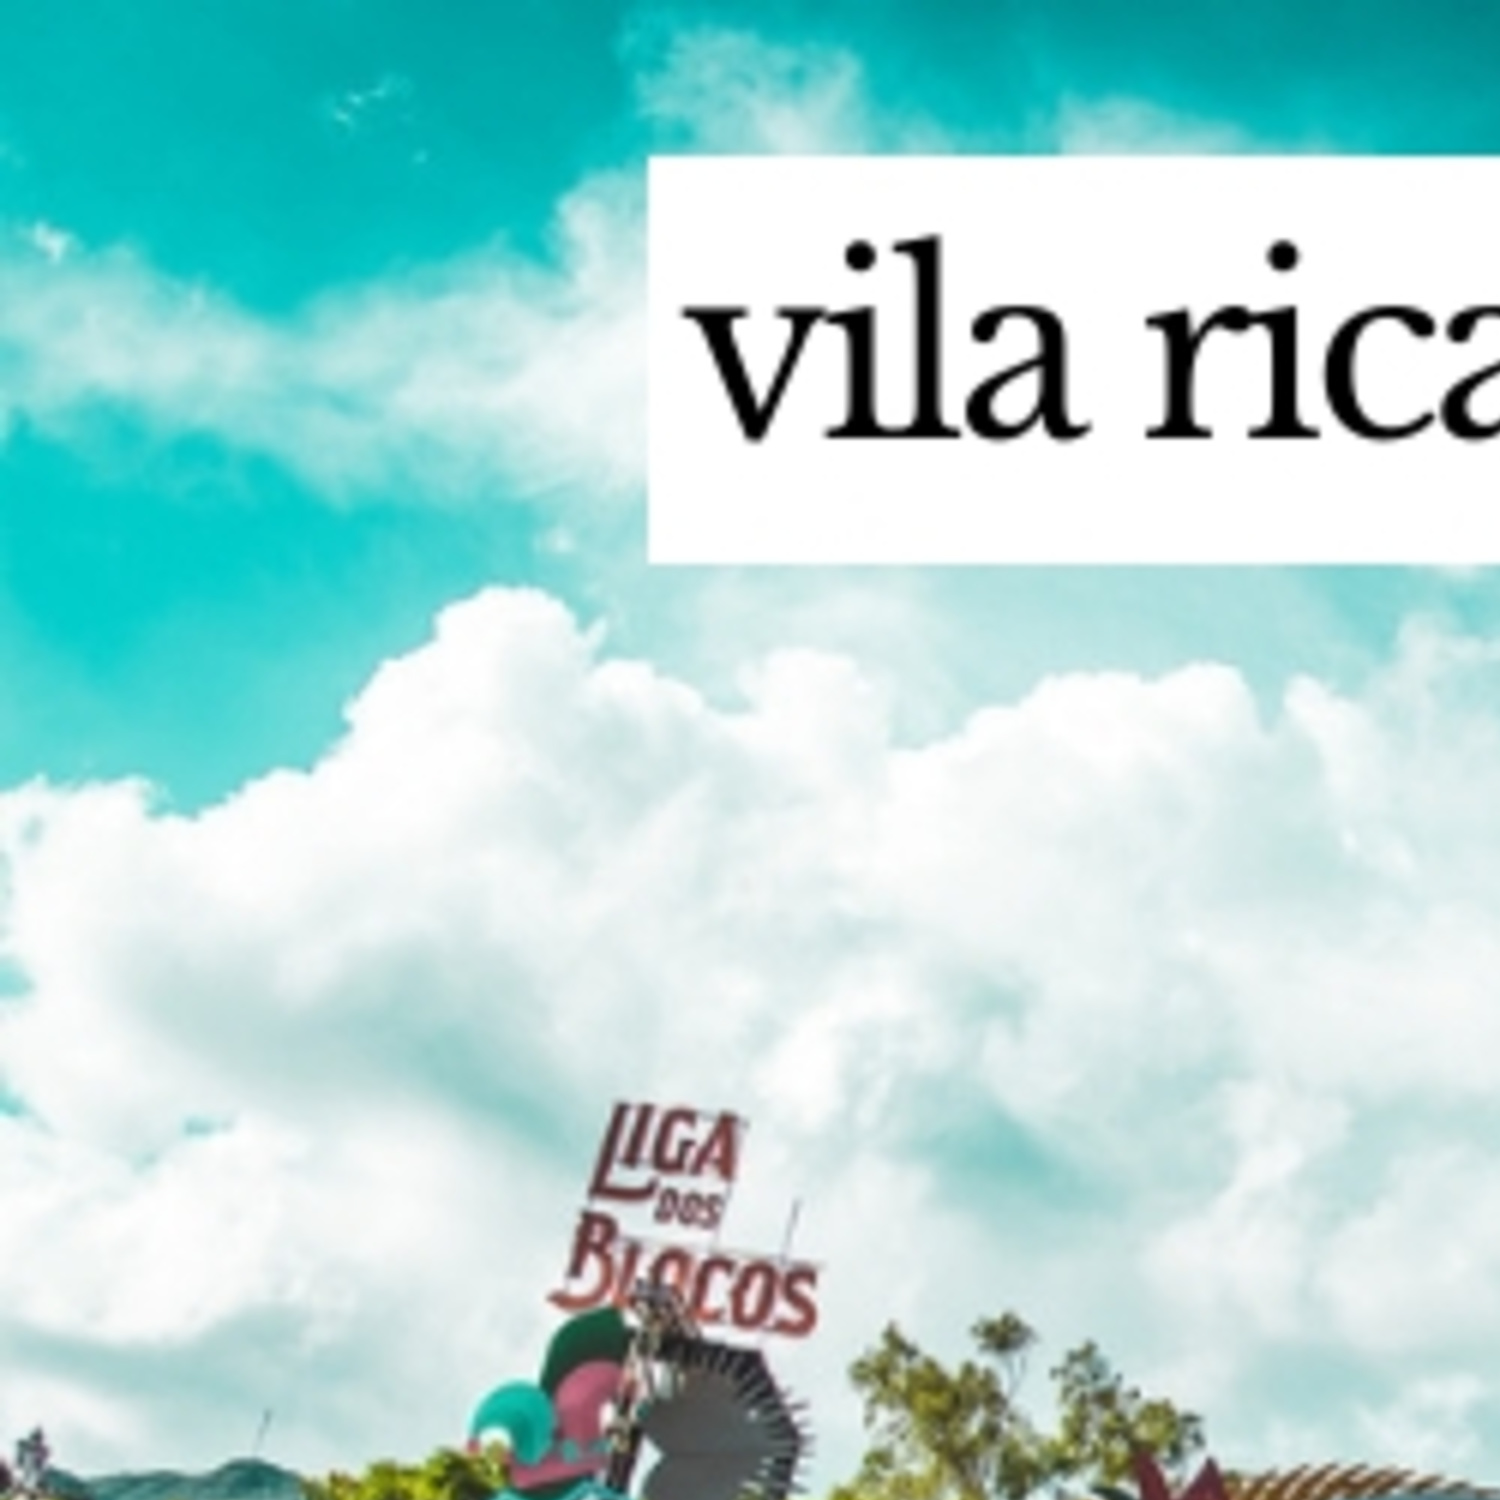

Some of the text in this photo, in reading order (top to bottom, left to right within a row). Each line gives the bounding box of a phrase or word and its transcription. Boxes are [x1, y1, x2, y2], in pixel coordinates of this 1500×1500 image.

[587, 1101, 740, 1204] LIGA
[653, 1186, 726, 1230] DOS
[546, 1208, 819, 1338] BLOCOS
